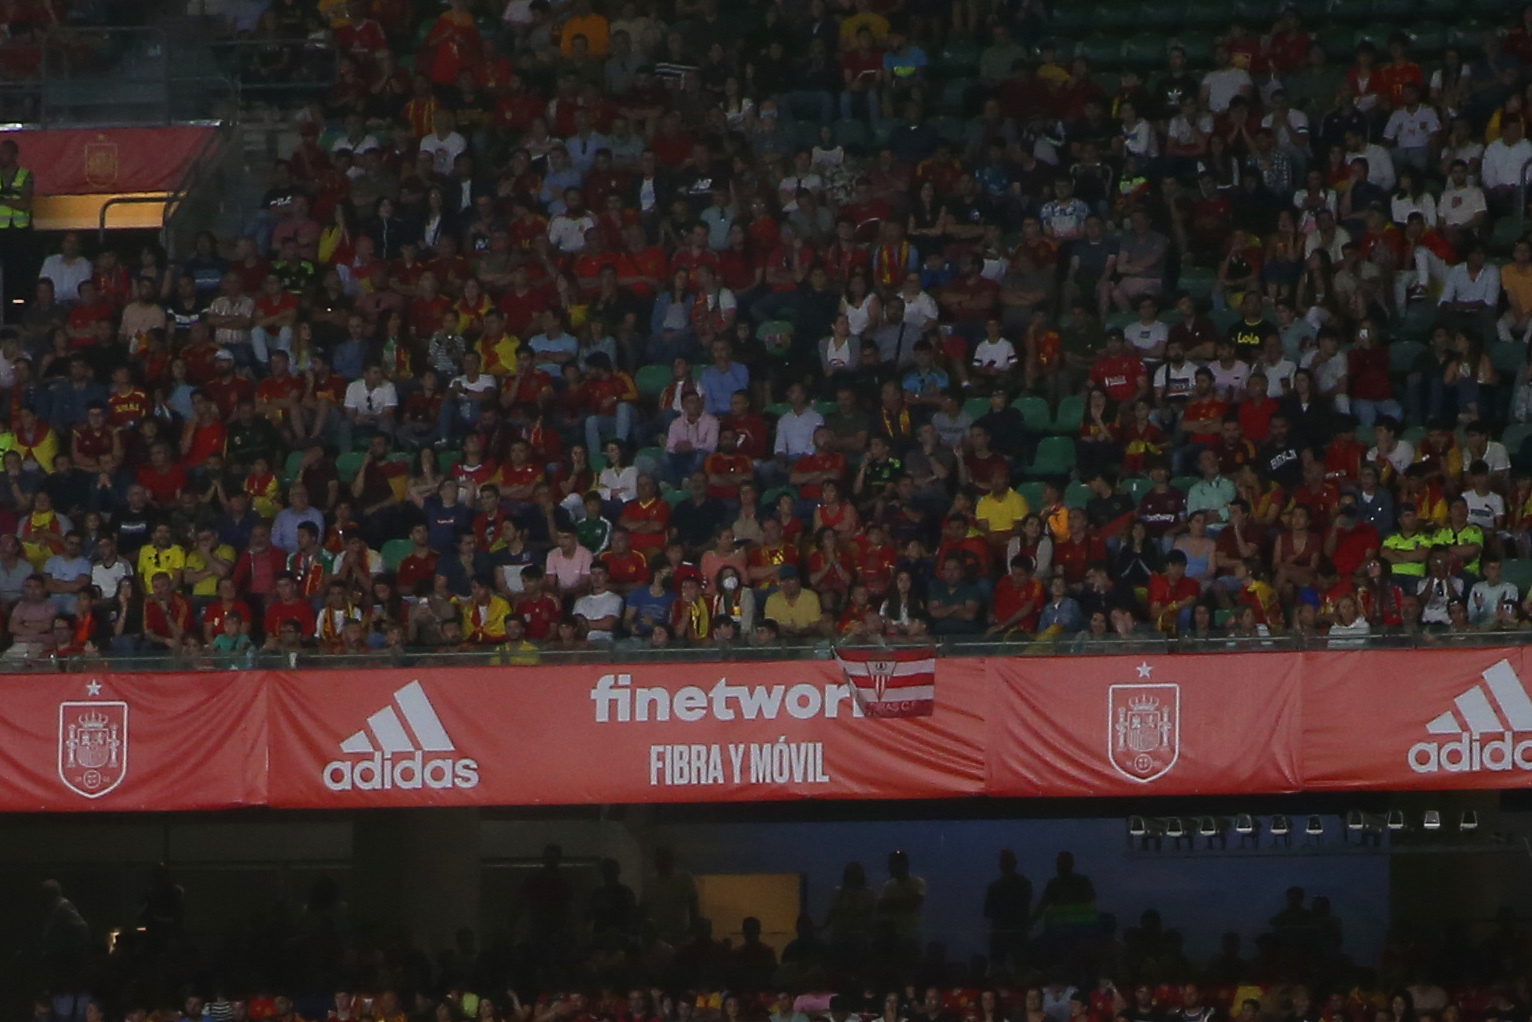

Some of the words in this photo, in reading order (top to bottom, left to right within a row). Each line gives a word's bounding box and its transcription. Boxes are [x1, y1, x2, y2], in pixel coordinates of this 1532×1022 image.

[590, 674, 864, 723] finetwor
[322, 751, 480, 791] adidas
[649, 743, 725, 786] FIBRA
[728, 743, 746, 784] Y
[750, 735, 830, 784] MÓVIL
